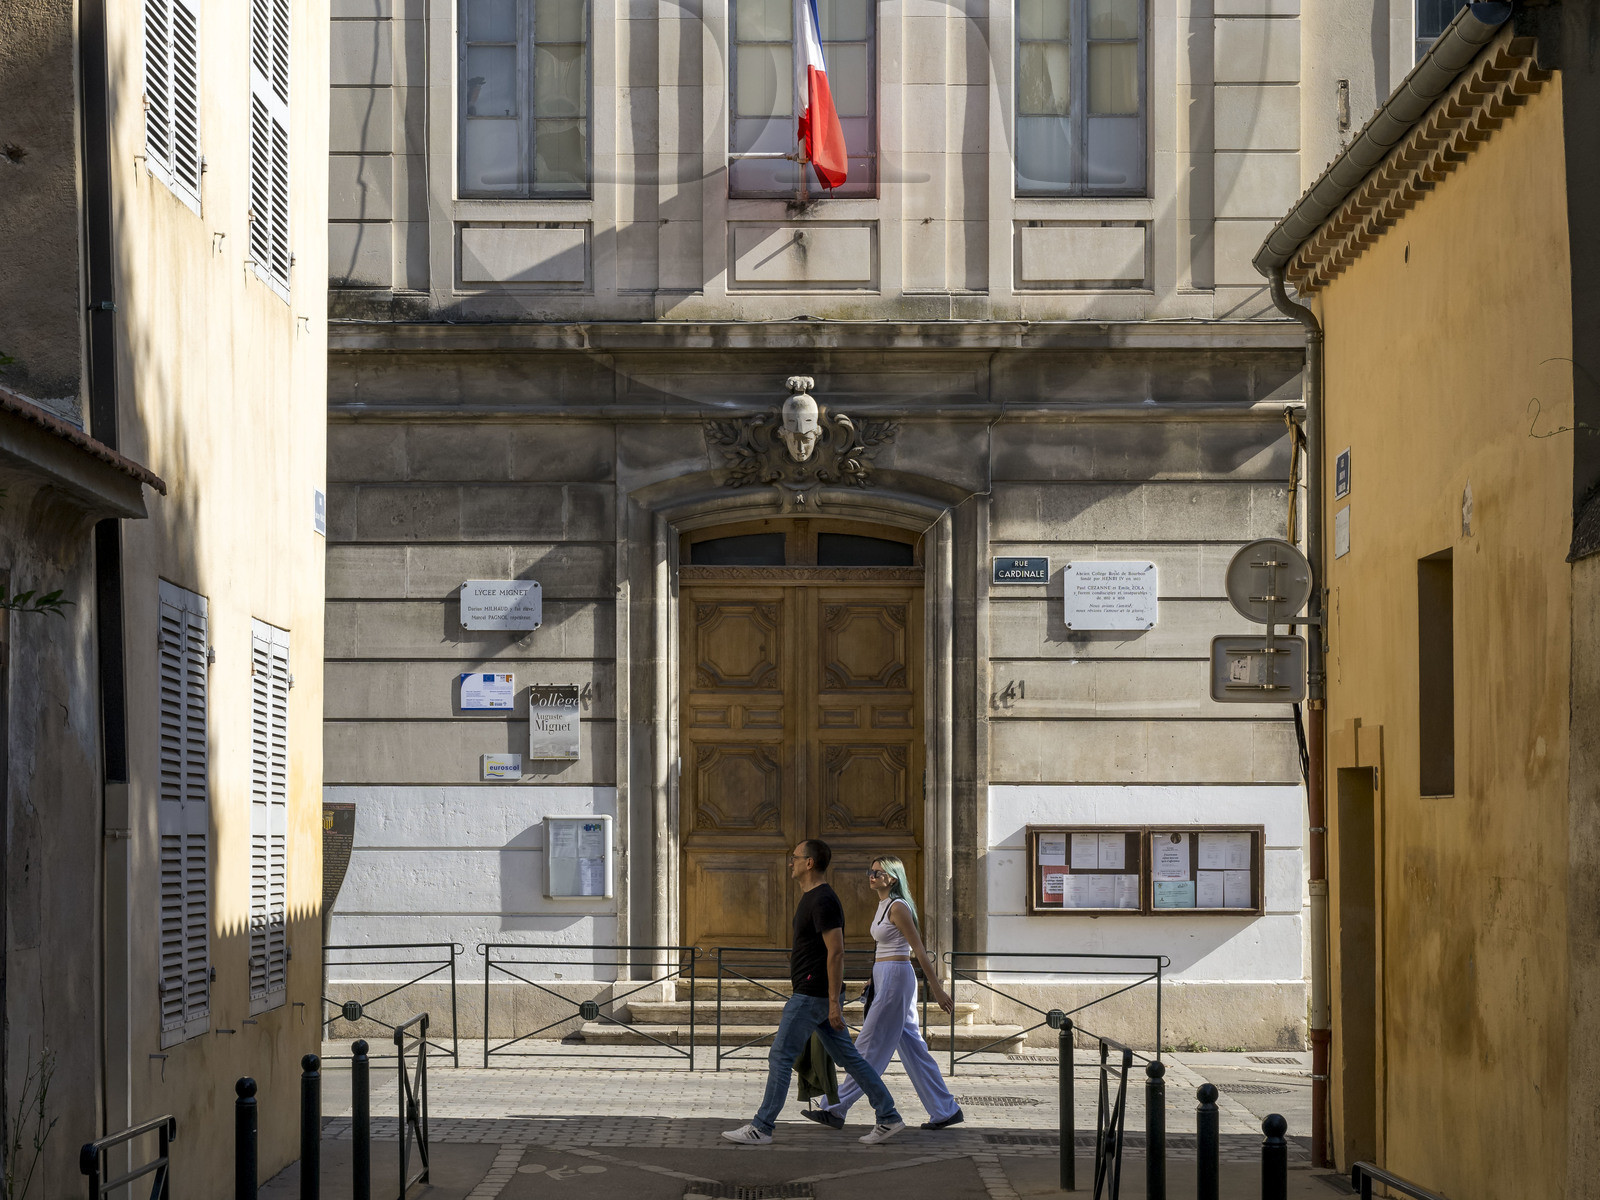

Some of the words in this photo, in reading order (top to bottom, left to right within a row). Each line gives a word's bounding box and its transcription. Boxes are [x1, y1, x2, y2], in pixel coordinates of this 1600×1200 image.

[998, 570, 1045, 578] CARDINALE
[530, 692, 579, 711] Collège
[535, 712, 563, 721] Auguste
[535, 719, 571, 736] Mignet
